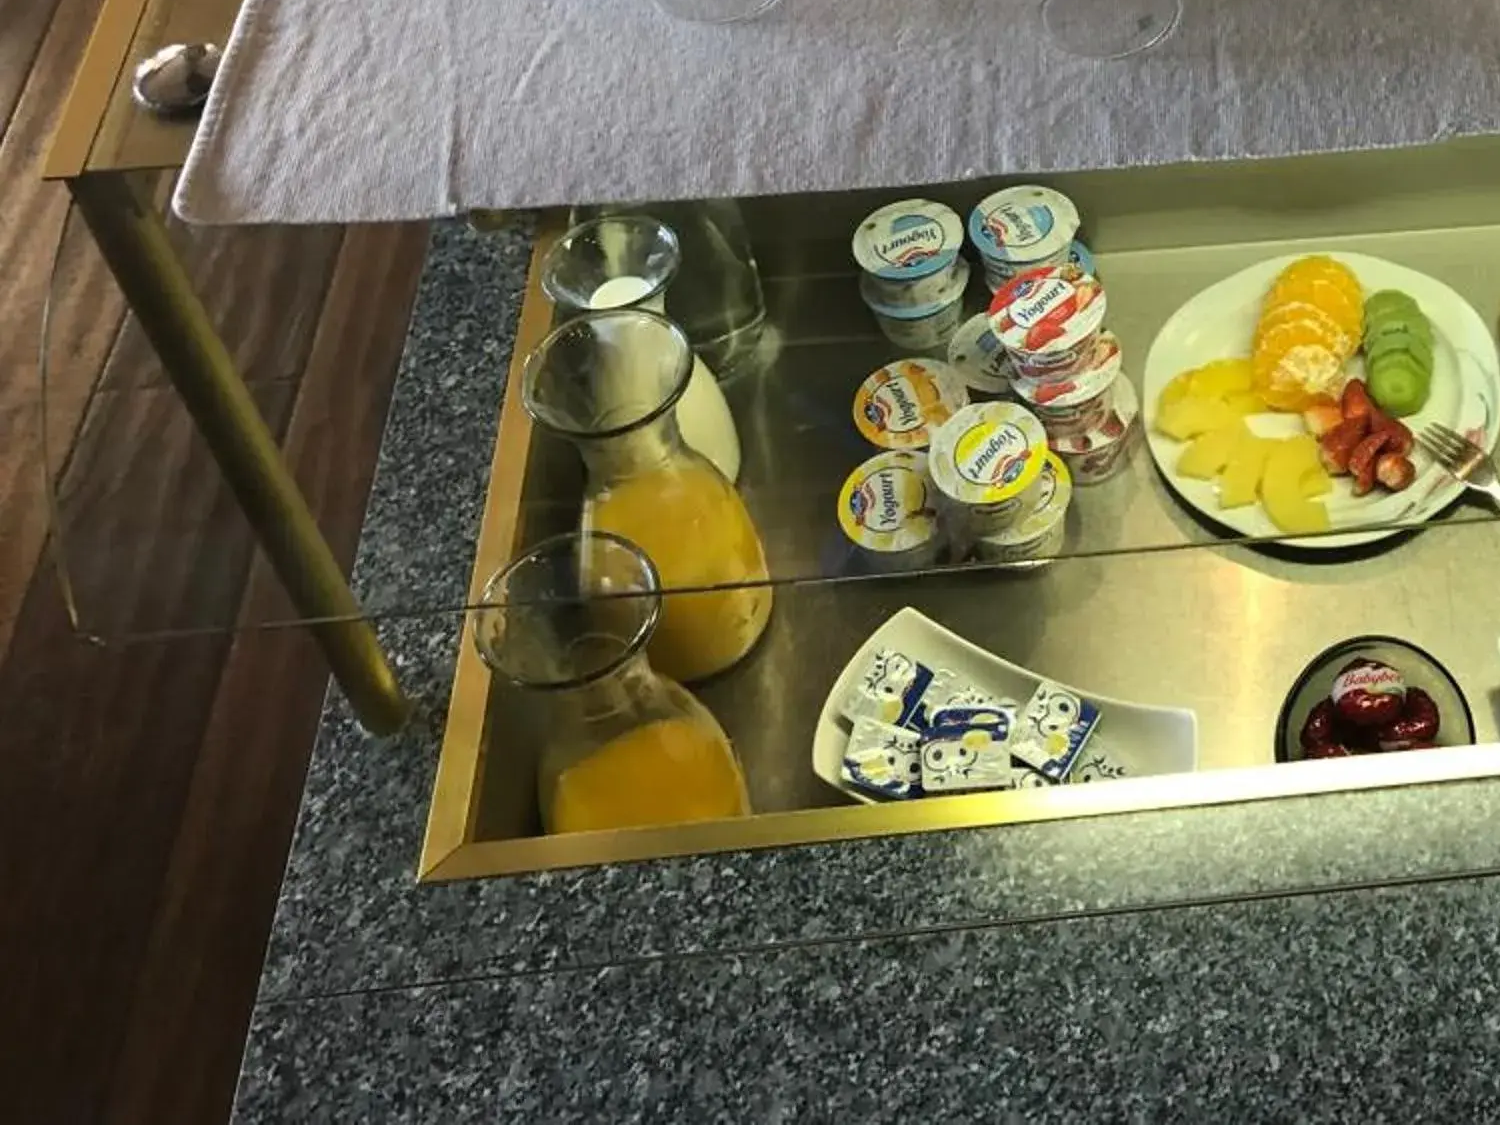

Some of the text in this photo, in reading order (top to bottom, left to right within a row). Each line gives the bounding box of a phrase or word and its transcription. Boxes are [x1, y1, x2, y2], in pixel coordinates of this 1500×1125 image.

[880, 227, 938, 254] Yogourt
[1015, 280, 1067, 322] Yogourt
[967, 427, 1019, 479] Yogourt
[879, 472, 898, 527] Yogourt
